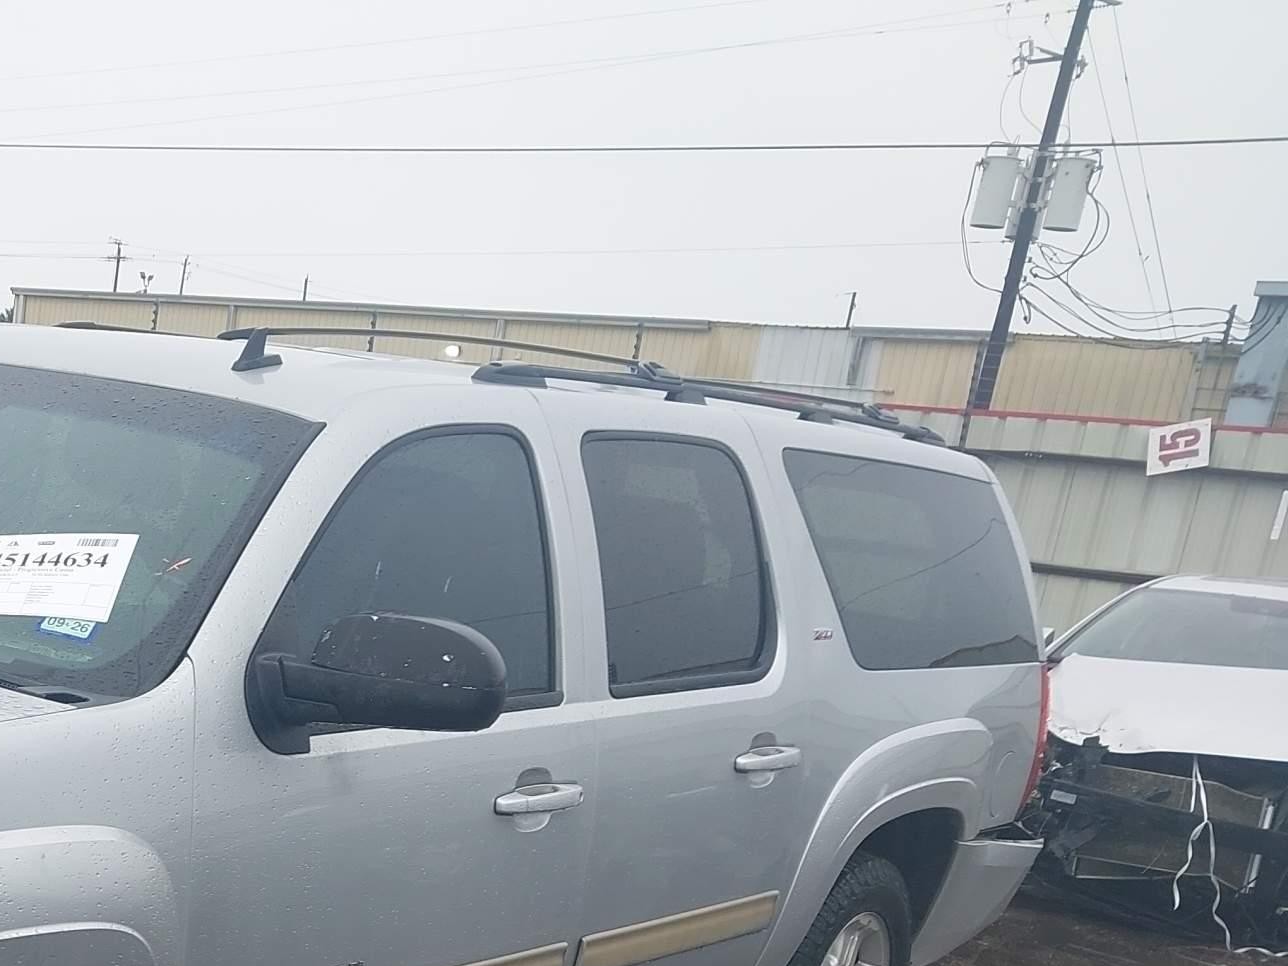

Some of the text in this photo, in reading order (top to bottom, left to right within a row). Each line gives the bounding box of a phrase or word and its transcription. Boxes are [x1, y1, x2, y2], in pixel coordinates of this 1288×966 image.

[1159, 427, 1201, 468] 15
[47, 616, 91, 634] 09 26
